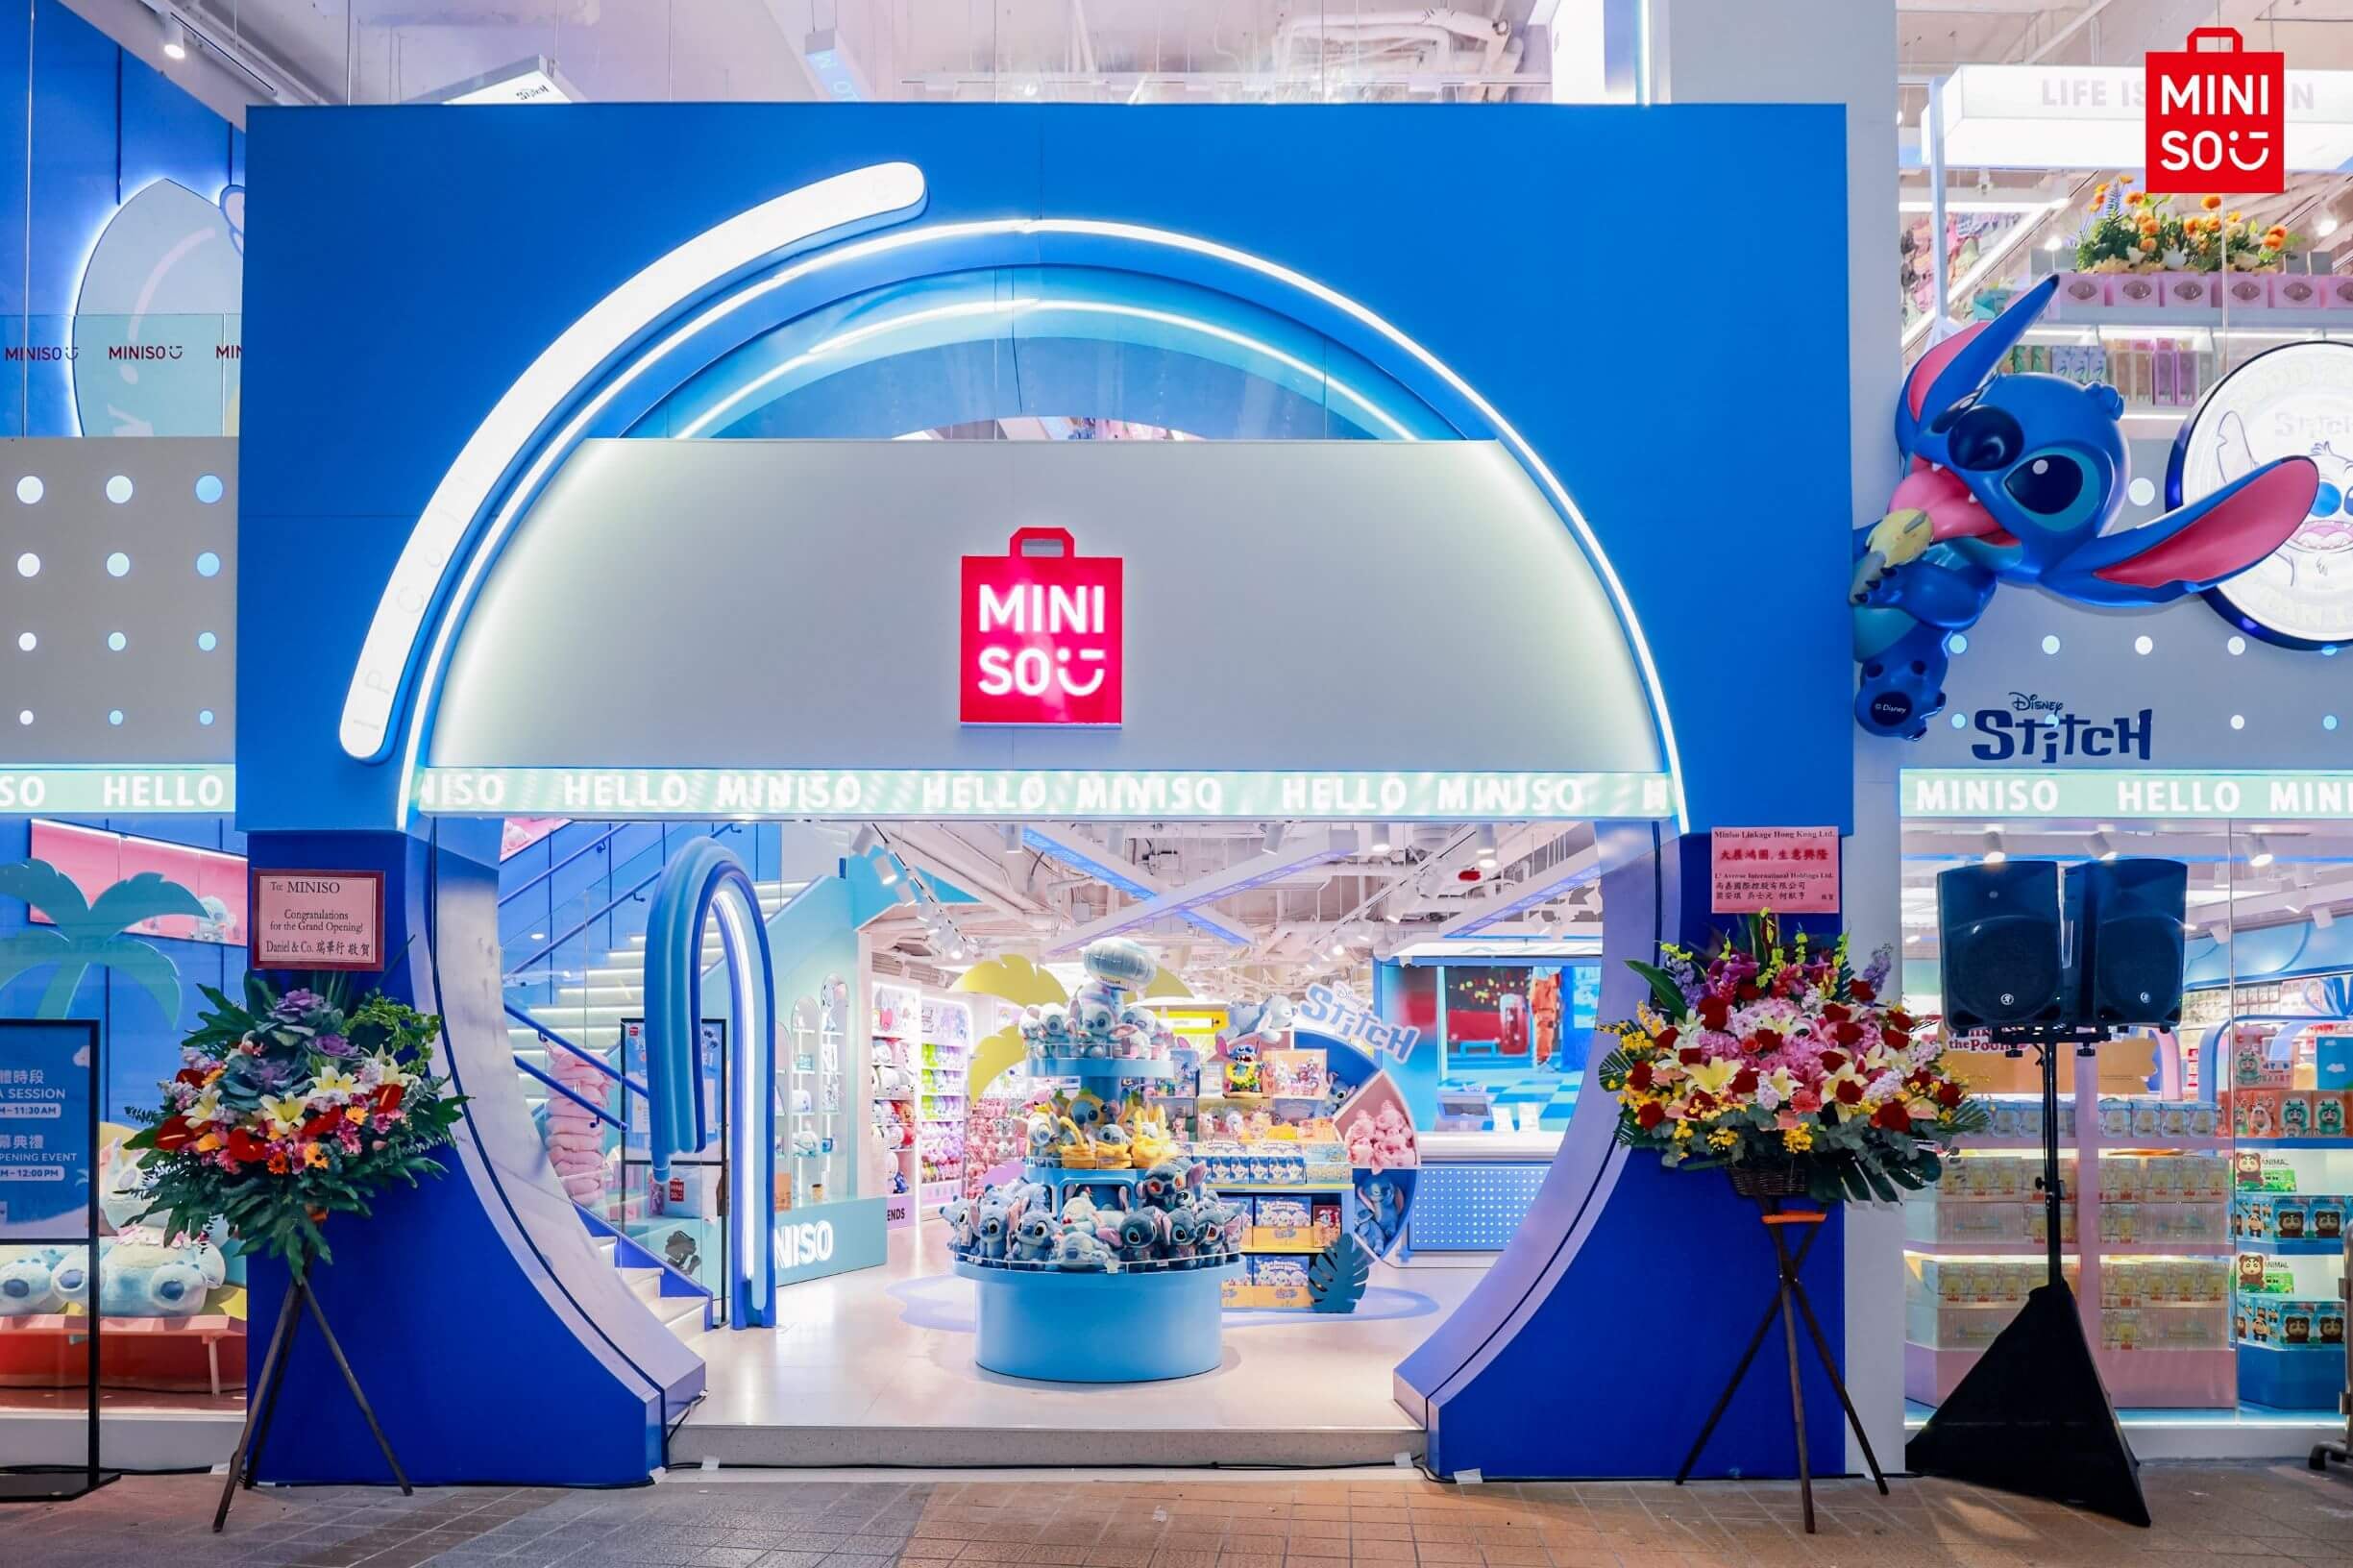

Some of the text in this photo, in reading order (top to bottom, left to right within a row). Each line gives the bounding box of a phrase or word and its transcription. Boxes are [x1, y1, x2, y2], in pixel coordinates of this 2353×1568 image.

[2042, 79, 2107, 107] LIFE
[5, 347, 61, 361] MINISO
[109, 346, 166, 360] MINISO
[978, 583, 1105, 634] MINI
[977, 646, 1051, 698] SO
[1882, 704, 1907, 714] Disney
[2008, 691, 2065, 718] Disney
[103, 774, 224, 808] HELLO
[564, 774, 688, 808] HELLO
[716, 774, 862, 809] MINISO
[922, 776, 1046, 810] HELLO
[1075, 776, 1222, 810] MINISO
[1282, 777, 1408, 810] HELLO
[1436, 777, 1583, 810] MINISO
[1916, 778, 2060, 812] MINISO
[2117, 779, 2242, 813] HELLO
[287, 881, 341, 894] MINISO
[284, 909, 349, 922] Congratulations
[270, 921, 282, 931] for
[283, 921, 296, 931] the
[298, 922, 324, 932] Grand
[266, 941, 290, 953] Daniel
[291, 942, 299, 953] &
[1949, 1040, 1969, 1049] the
[8, 1088, 66, 1100] SESSION
[41, 1153, 78, 1162] EVENT
[887, 1208, 906, 1221] ENDS
